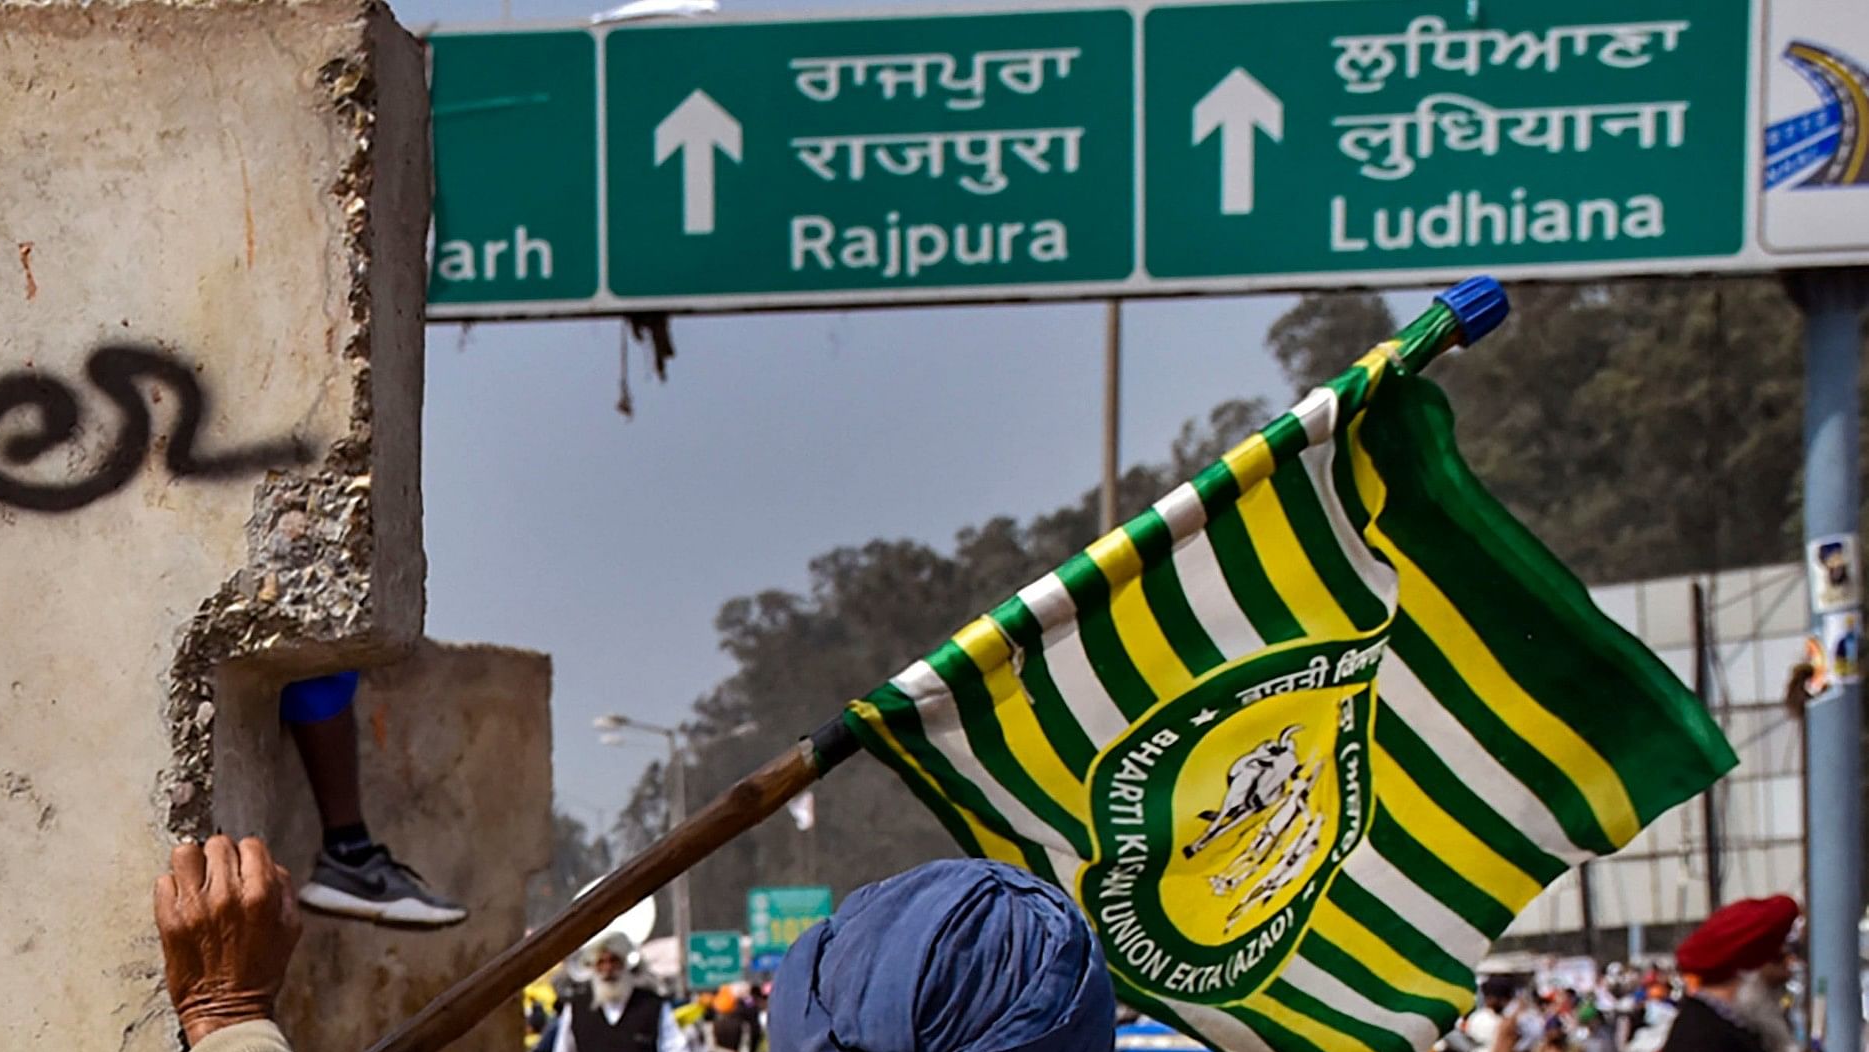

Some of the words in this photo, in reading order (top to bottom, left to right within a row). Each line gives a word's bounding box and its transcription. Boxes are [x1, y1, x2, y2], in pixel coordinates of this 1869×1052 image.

[790, 47, 1080, 110] ਰਾਜਪੁਰਾ
[1332, 16, 1689, 94] ਲੁਧਿਆਣਾ
[790, 127, 1084, 194] राजपुरा
[1333, 93, 1689, 180] लुधियाना
[438, 225, 553, 281] arh
[790, 212, 1069, 277] Rajpura
[1330, 187, 1664, 254] Ludhiana
[1109, 729, 1180, 824] BHARTI
[1101, 901, 1171, 981] UNION
[1226, 907, 1294, 986] (AZAD)
[1164, 962, 1223, 993] EKTA
